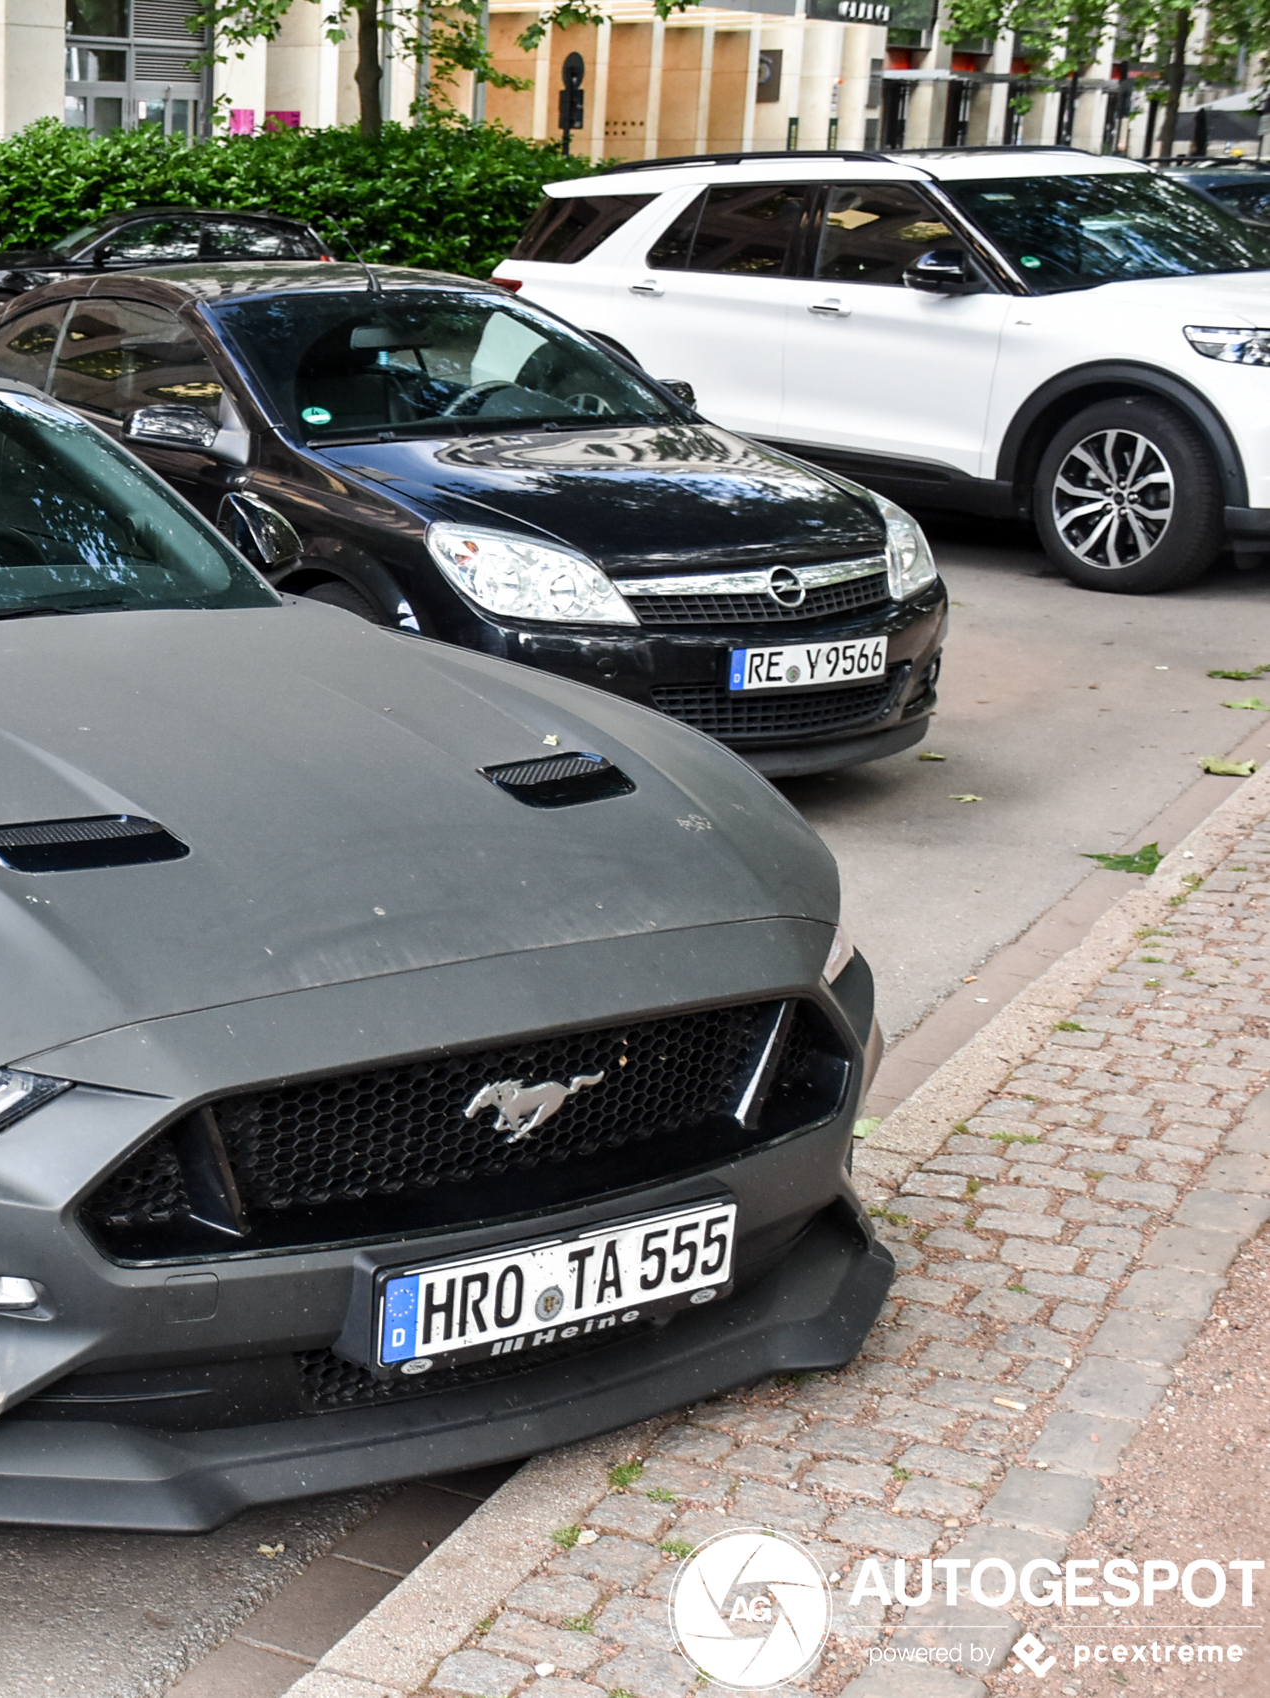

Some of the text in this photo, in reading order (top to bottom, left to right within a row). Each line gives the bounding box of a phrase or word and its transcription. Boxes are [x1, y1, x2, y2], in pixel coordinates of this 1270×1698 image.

[733, 673, 741, 684] D
[747, 651, 784, 684] RE
[421, 1214, 730, 1345] HRO TA 555
[392, 1327, 406, 1348] D
[532, 1309, 640, 1346] Heine
